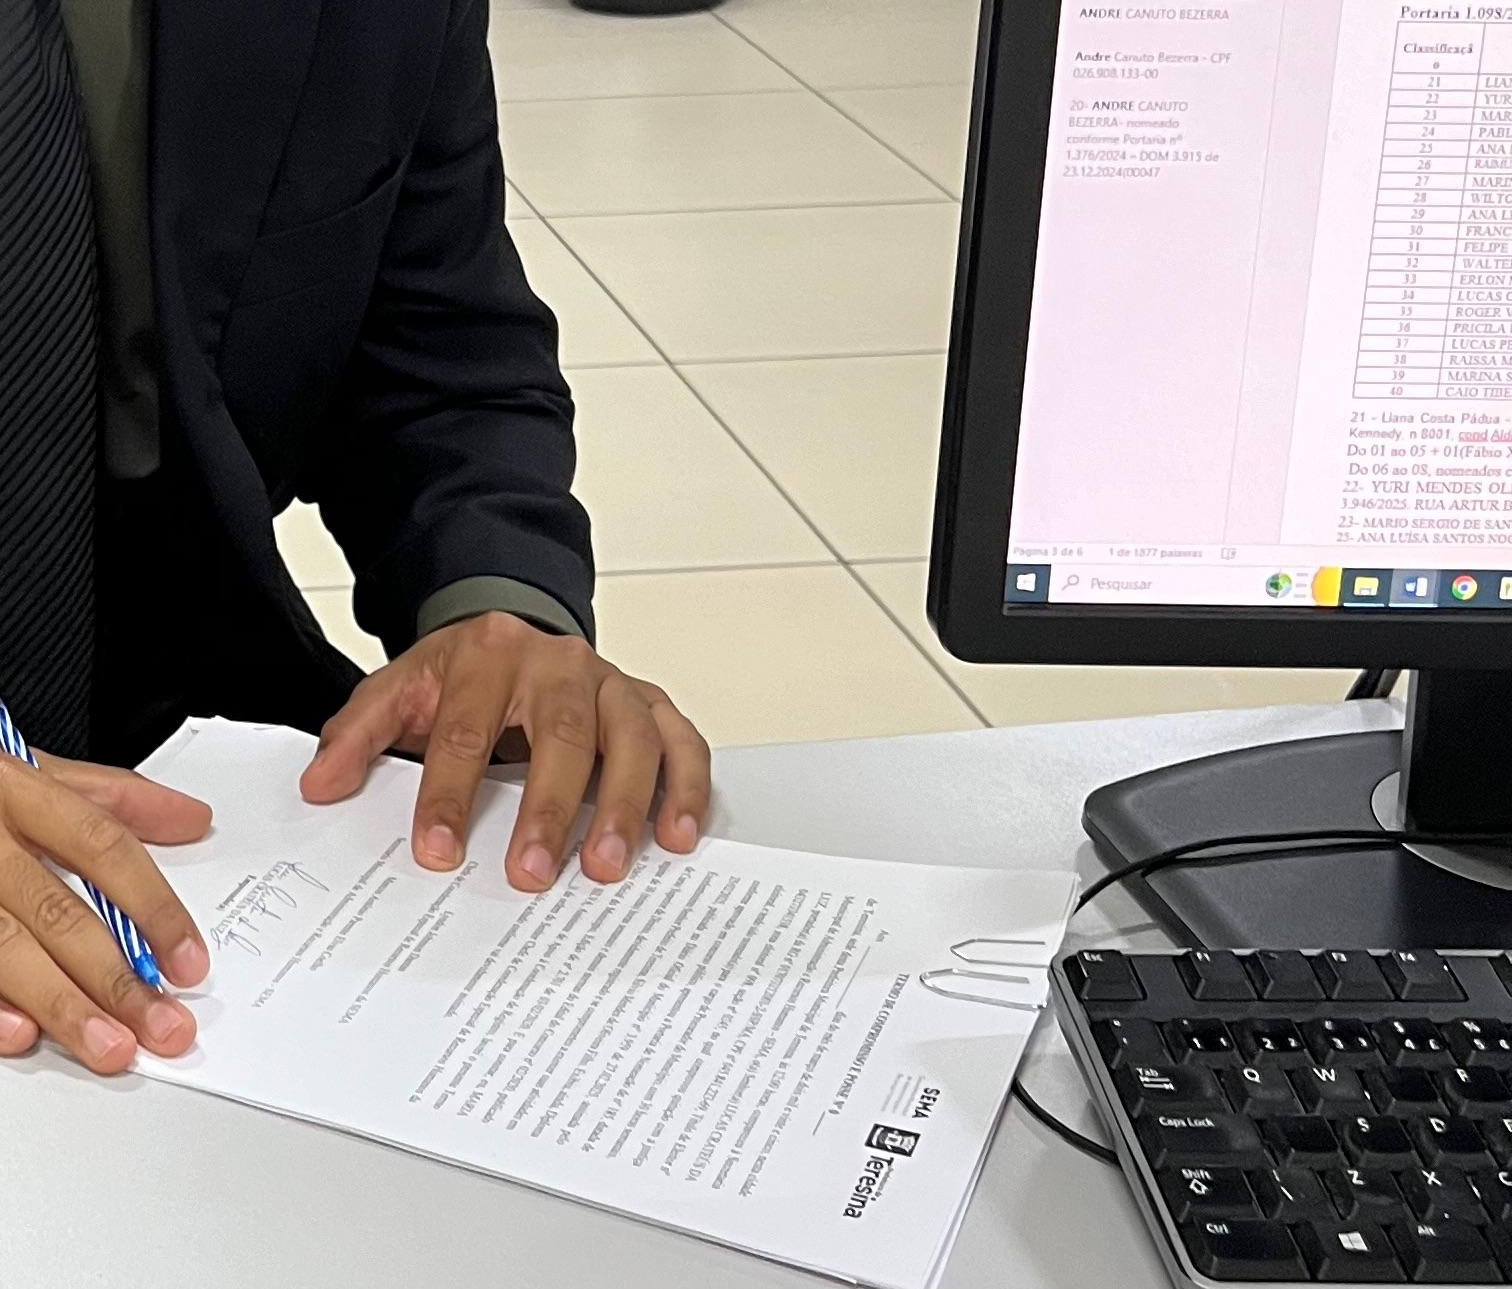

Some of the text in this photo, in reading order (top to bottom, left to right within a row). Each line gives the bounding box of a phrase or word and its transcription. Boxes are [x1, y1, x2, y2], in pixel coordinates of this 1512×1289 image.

[1080, 8, 1229, 20] ANDRE CANUTO BEZERRA
[1400, 6, 1460, 18] Portaria
[1076, 52, 1232, 64] Andre Canuto Bezerra CPF
[1428, 77, 1441, 87] 21
[1092, 101, 1188, 112] ANDRE CANUTO
[1424, 110, 1437, 121] 23
[1127, 119, 1179, 128] nomeado
[1421, 127, 1435, 137] 24
[1067, 134, 1166, 145] conforme Portaria
[1419, 143, 1433, 153] 25
[1477, 144, 1506, 155] ANA
[1140, 151, 1169, 161] DOM
[1205, 152, 1219, 162] de
[1415, 176, 1429, 186] 27
[1411, 209, 1425, 220] 29
[1468, 209, 1497, 220] ANA
[1408, 242, 1420, 252] 31
[1464, 242, 1508, 253] FELIPE
[1406, 258, 1419, 268] 32
[1404, 274, 1417, 284] 33
[1459, 275, 1505, 285] ERLON
[1457, 291, 1502, 301] LUCAS
[1455, 307, 1501, 317] ROGER
[1453, 323, 1505, 333] PRICILA
[1452, 339, 1496, 349] LUCAS
[1450, 355, 1497, 366] RAISSA
[1448, 371, 1502, 382] MARINA
[1446, 387, 1478, 397] CAIO
[1350, 412, 1365, 423] 21
[1420, 412, 1455, 424] Costa
[1461, 413, 1500, 424] Pádua
[1459, 429, 1488, 441] cond
[1347, 444, 1366, 456] Do
[1371, 444, 1386, 456] 01
[1391, 448, 1406, 457] ao
[1410, 445, 1427, 457] 05
[1349, 463, 1368, 475] Do
[1372, 464, 1388, 475] 06
[1392, 467, 1407, 475] ao
[1436, 465, 1501, 477] nomeados
[1371, 481, 1410, 493] YURI
[1416, 481, 1482, 494] MENDES
[1414, 499, 1445, 510] RUA
[1449, 499, 1499, 511] ARTUR
[1363, 518, 1408, 528] MARIO
[1412, 519, 1460, 529] SERGIO
[1463, 519, 1481, 529] DE
[1357, 532, 1386, 543] ANA
[1433, 533, 1484, 544] SANTOS
[1061, 547, 1073, 556] de
[1117, 548, 1130, 557] de
[1090, 577, 1152, 591] Pesquisar
[886, 972, 910, 1000] TERMO
[336, 1002, 364, 1025] SEMA
[851, 1009, 891, 1068] COMPROMISSO
[1262, 1038, 1274, 1050] 2
[1404, 1039, 1416, 1050] 4
[1136, 1067, 1159, 1077] Tab
[1243, 1068, 1262, 1083] Q
[1312, 1067, 1336, 1082] W
[1455, 1068, 1471, 1083] R
[912, 1087, 940, 1118] SEMA
[711, 1102, 741, 1132] LUCAS
[1159, 1116, 1215, 1128] Caps Lock
[1357, 1117, 1369, 1132] S
[1430, 1117, 1446, 1132] D
[682, 1167, 704, 1184] DA
[1182, 1168, 1213, 1180] Shift
[1347, 1169, 1365, 1185] Z
[1421, 1170, 1442, 1186] X
[843, 1155, 894, 1219] Teresina
[1206, 1223, 1230, 1235] Ctrl
[1417, 1225, 1436, 1237] Alt
